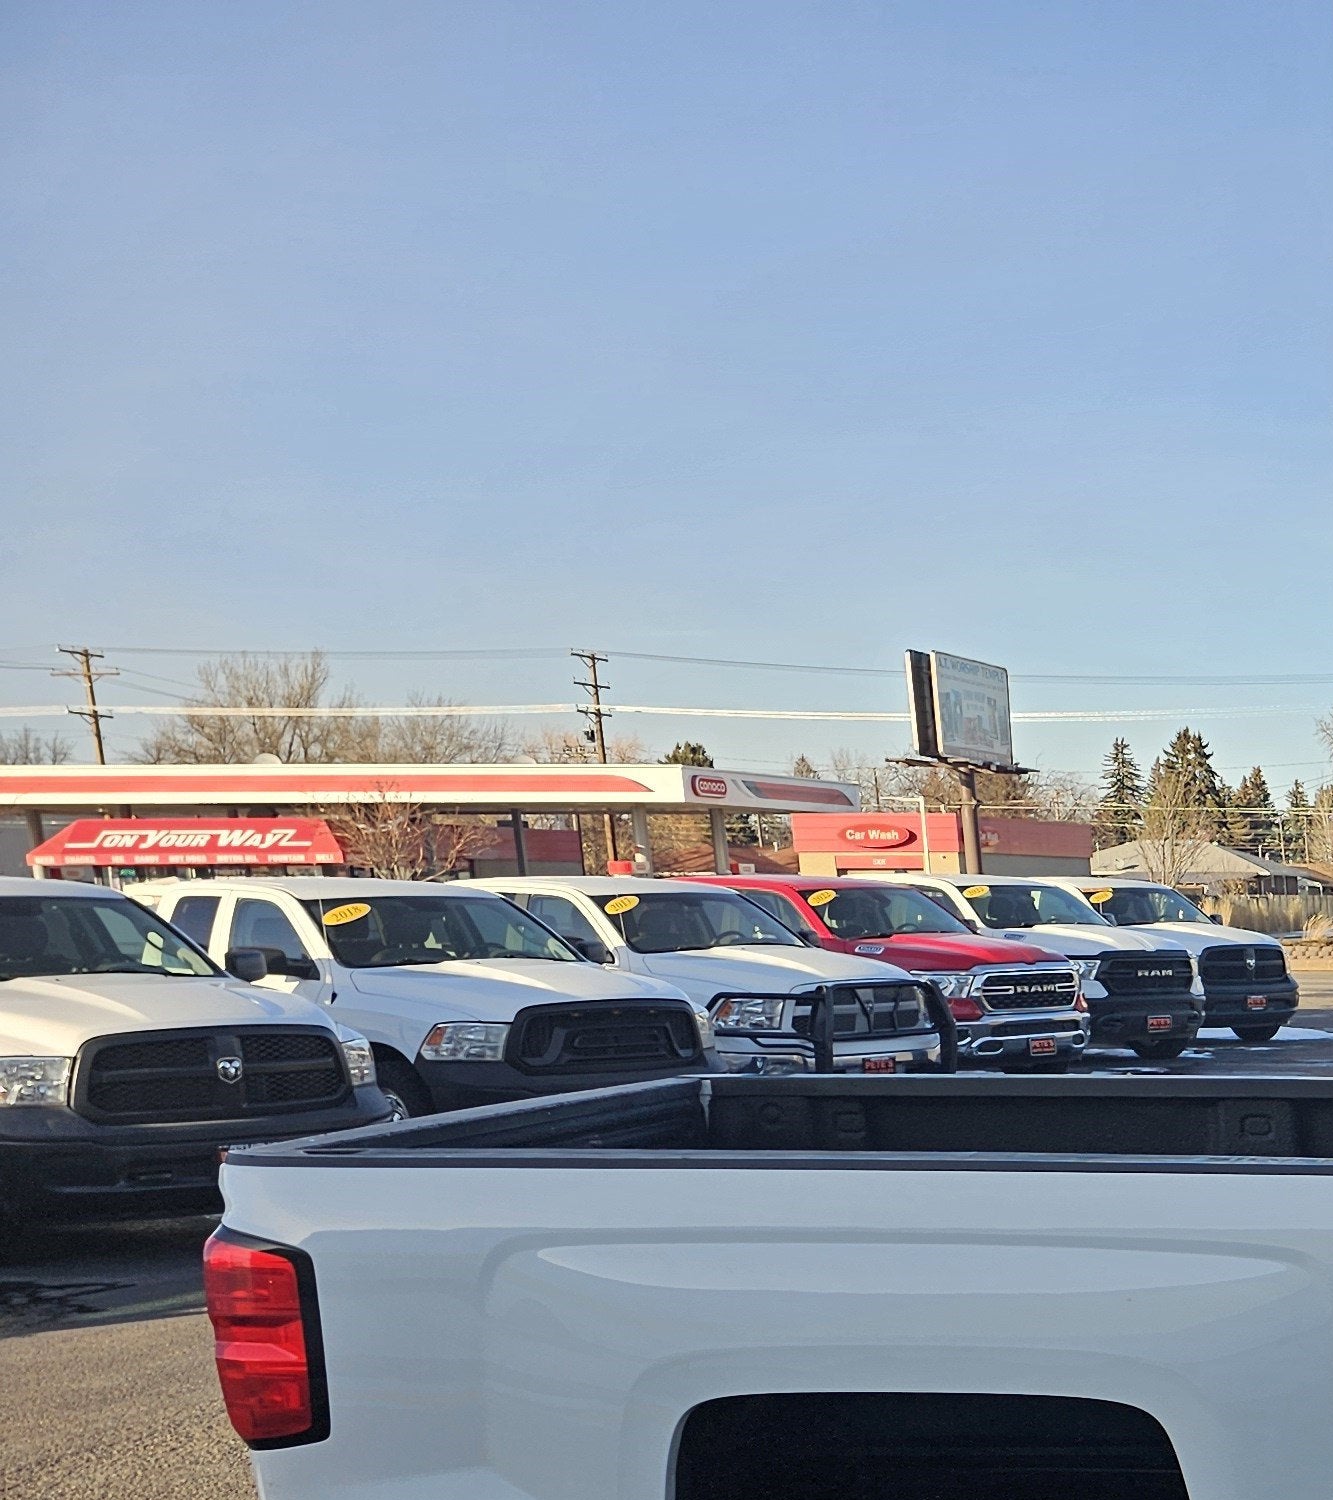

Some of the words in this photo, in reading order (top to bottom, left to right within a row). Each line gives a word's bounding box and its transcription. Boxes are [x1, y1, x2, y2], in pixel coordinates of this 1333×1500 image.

[845, 829, 866, 840] Car
[867, 828, 900, 840] Wash
[1137, 969, 1173, 977] RAM
[1016, 984, 1055, 993] RAM
